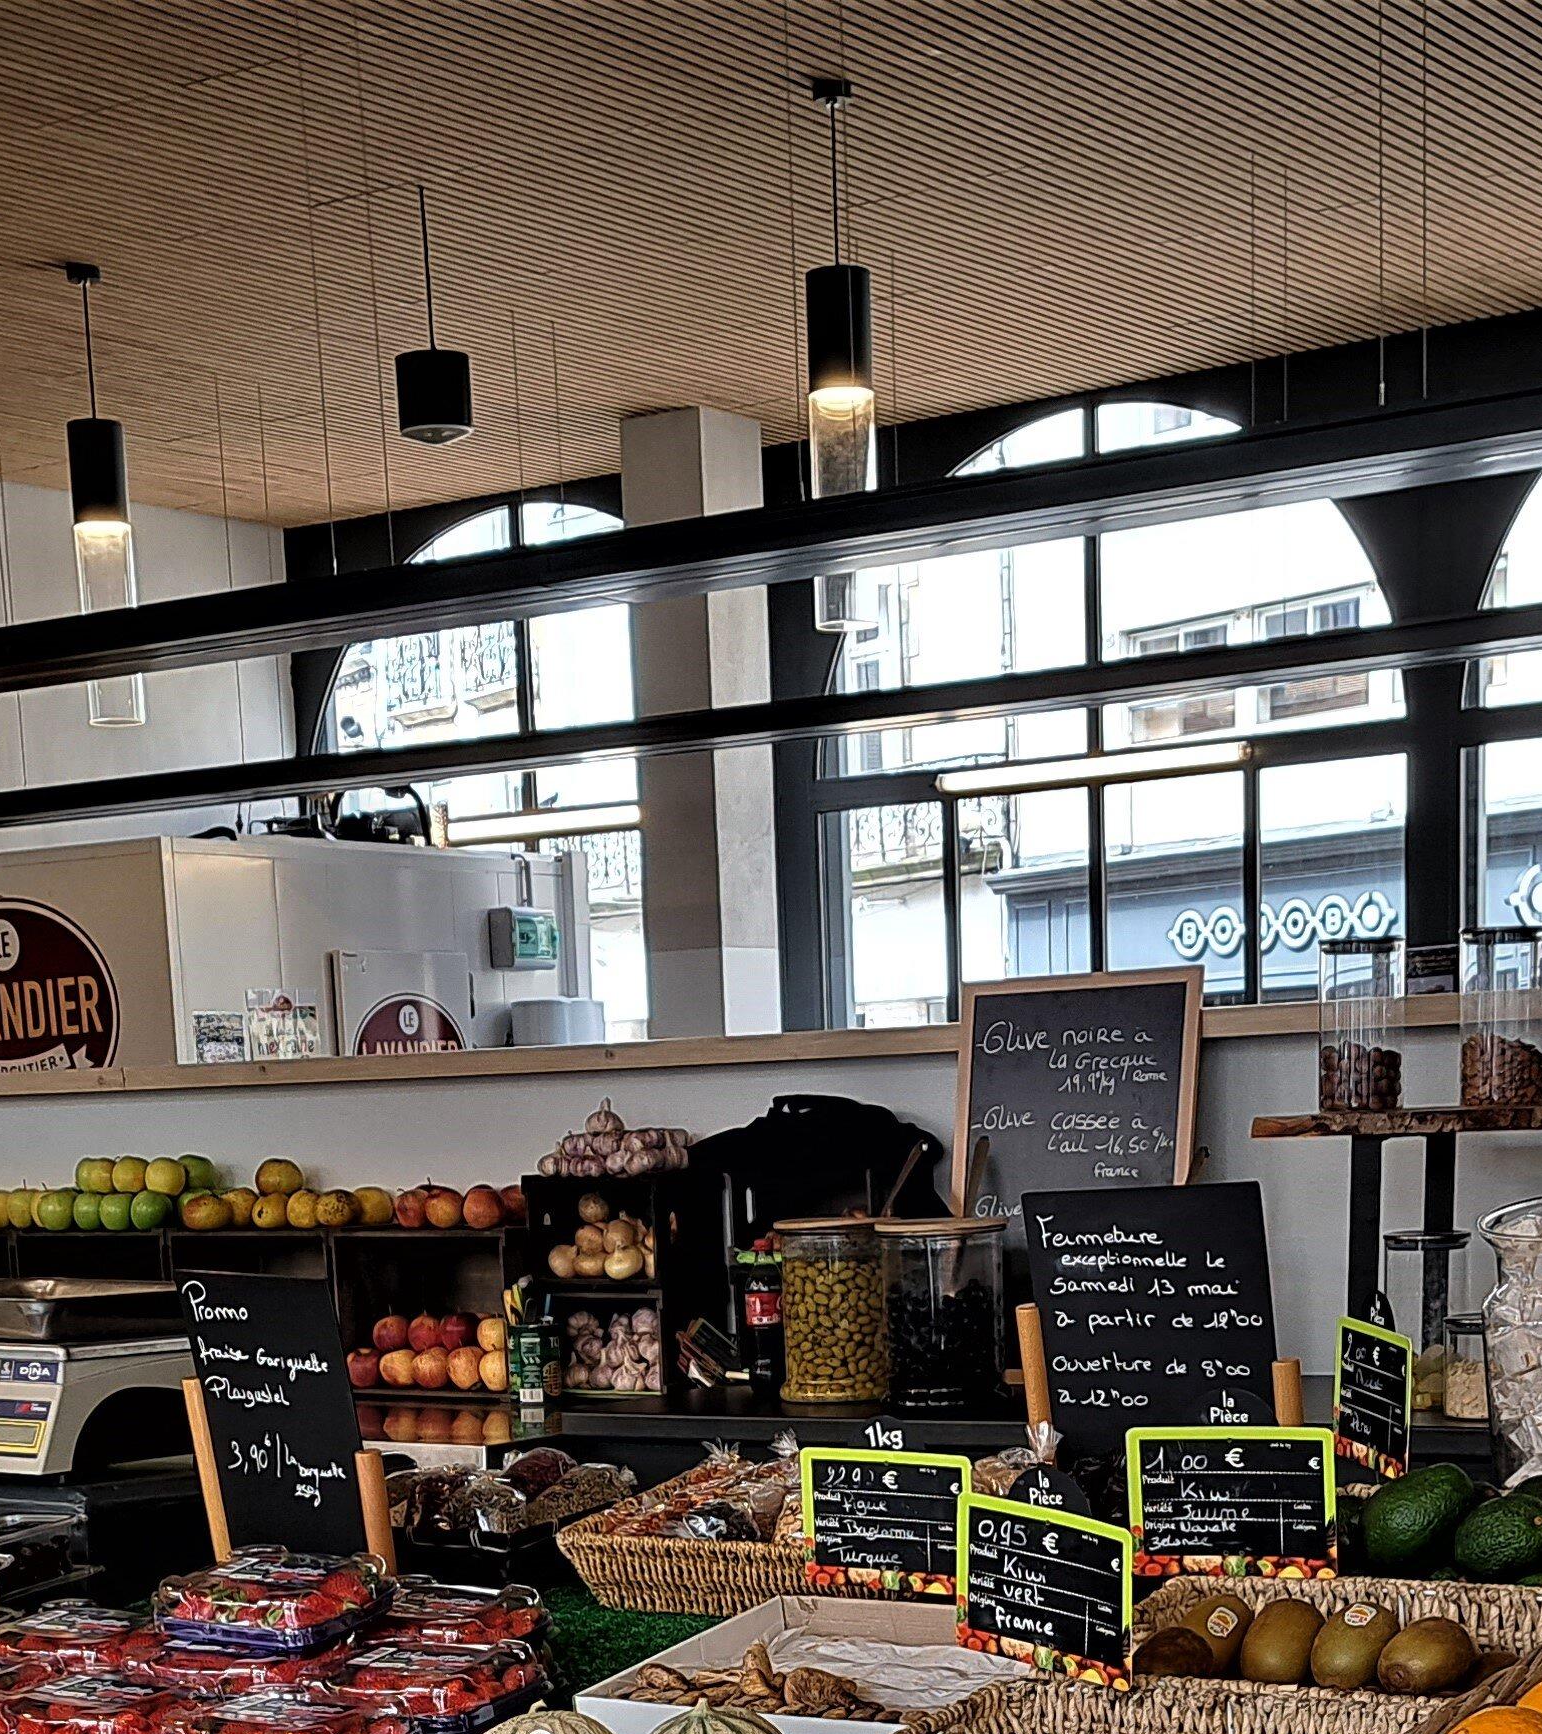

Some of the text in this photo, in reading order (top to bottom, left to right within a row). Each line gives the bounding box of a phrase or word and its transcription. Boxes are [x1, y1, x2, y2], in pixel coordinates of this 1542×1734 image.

[402, 1012, 414, 1028] LE
[1048, 1049, 1067, 1069] la
[1035, 1214, 1164, 1249] Fermeture
[1061, 1250, 1187, 1272] exceptionnelle
[1049, 1277, 1241, 1297] Samedi 13 mai
[182, 1280, 249, 1322] Promo
[1088, 1308, 1156, 1334] partir
[1172, 1313, 1195, 1329] de
[1052, 1351, 1152, 1373] Ouverture
[1165, 1358, 1187, 1375] de
[1222, 1390, 1235, 1408] la
[1209, 1406, 1249, 1424] Pièce
[864, 1421, 904, 1450] 1kg
[1224, 1447, 1245, 1468] €
[882, 1470, 899, 1490] €
[1037, 1470, 1050, 1488] la
[1028, 1487, 1063, 1507] Pièce
[1042, 1532, 1060, 1555] €
